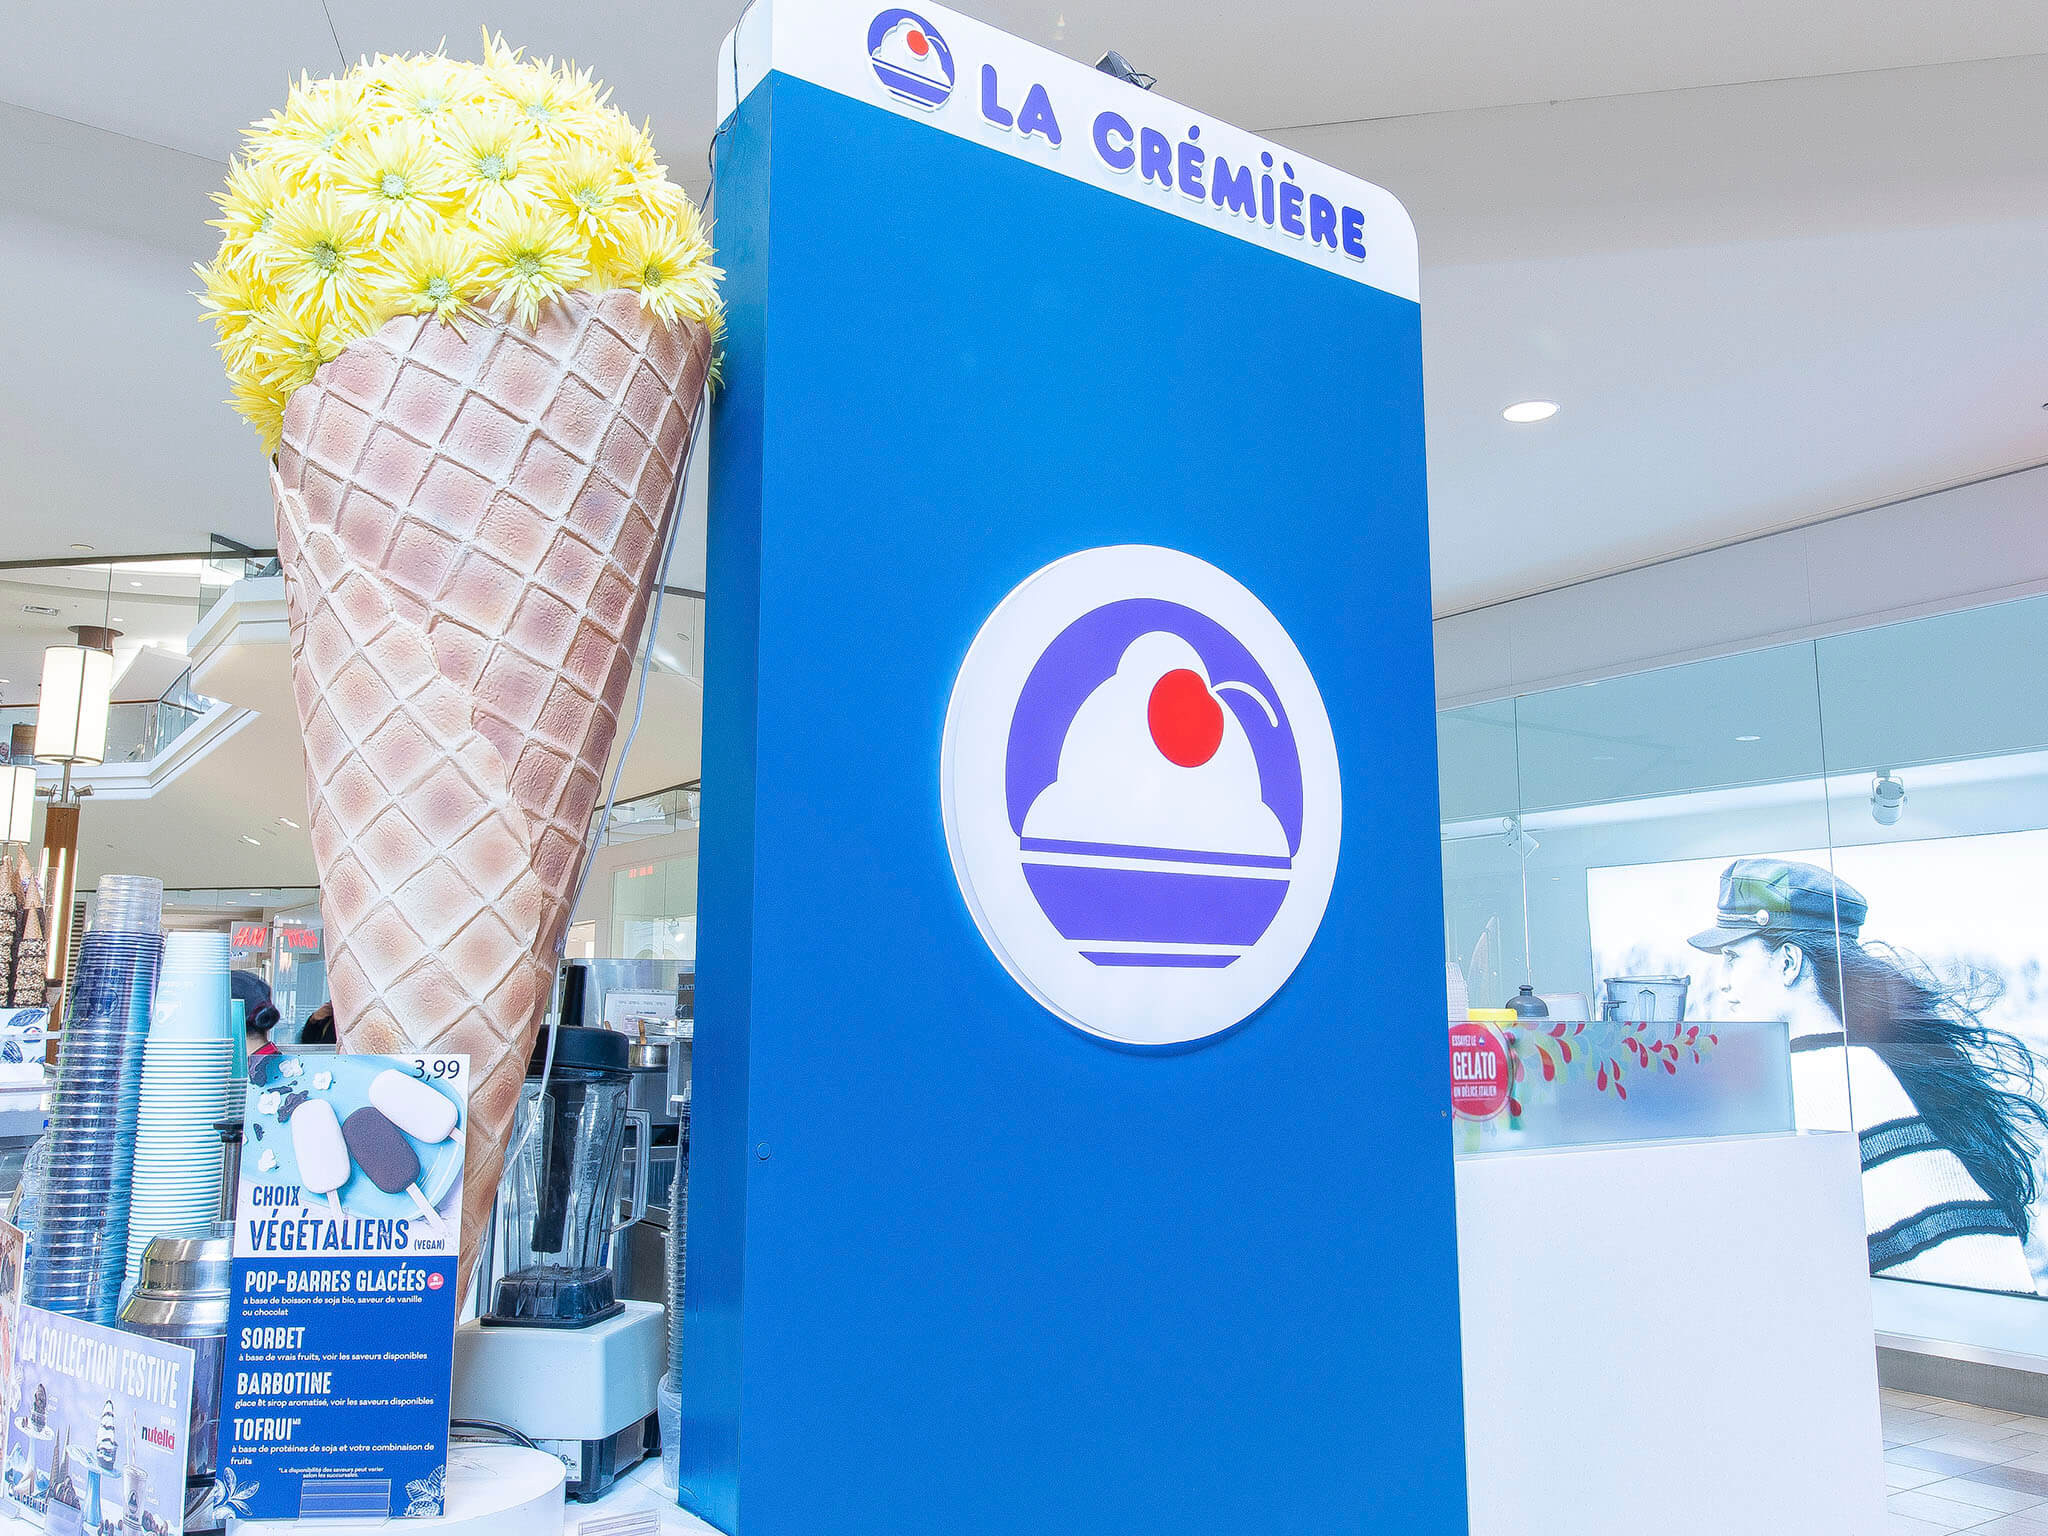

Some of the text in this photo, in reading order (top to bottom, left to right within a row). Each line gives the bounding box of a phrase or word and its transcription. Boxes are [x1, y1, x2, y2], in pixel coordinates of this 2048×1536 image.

[981, 63, 1062, 146] LA
[412, 1059, 460, 1082] 3,99
[1453, 1051, 1497, 1080] GELATO
[252, 1186, 301, 1206] CHOIX
[250, 1208, 445, 1251] VÉGÉTALIENS (VEGAN)
[245, 1262, 426, 1293] POP-BARRES GLACÉES
[254, 1308, 289, 1316] chocolat
[269, 1296, 280, 1304] de
[281, 1296, 312, 1304] boisson
[312, 1296, 323, 1304] de
[324, 1296, 340, 1306] soja
[341, 1296, 356, 1305] bio,
[385, 1295, 395, 1303] de
[396, 1295, 423, 1303] vanille
[240, 1326, 306, 1350] SORBET
[22, 1320, 181, 1409] LA COLLECTION FESTIVE
[245, 1353, 264, 1361] base
[265, 1353, 276, 1361] de
[297, 1352, 320, 1361] fruits,
[339, 1352, 350, 1360] les
[382, 1351, 428, 1361] disponibles
[236, 1371, 332, 1395] BARBOTINE
[234, 1398, 257, 1409] glace
[267, 1398, 287, 1408] sirop
[288, 1398, 329, 1408] aromatisé,
[330, 1398, 345, 1406] voir
[346, 1397, 358, 1406] les
[389, 1397, 434, 1407] disponibles
[141, 1424, 176, 1450] nutella
[238, 1445, 257, 1453] base
[270, 1444, 308, 1454] protéines
[309, 1444, 320, 1452] de
[321, 1444, 338, 1454] soja
[339, 1444, 348, 1452] et
[371, 1443, 423, 1451] combinaison
[423, 1443, 435, 1451] de
[230, 1457, 252, 1465] fruits
[288, 1466, 322, 1474] disponibilité
